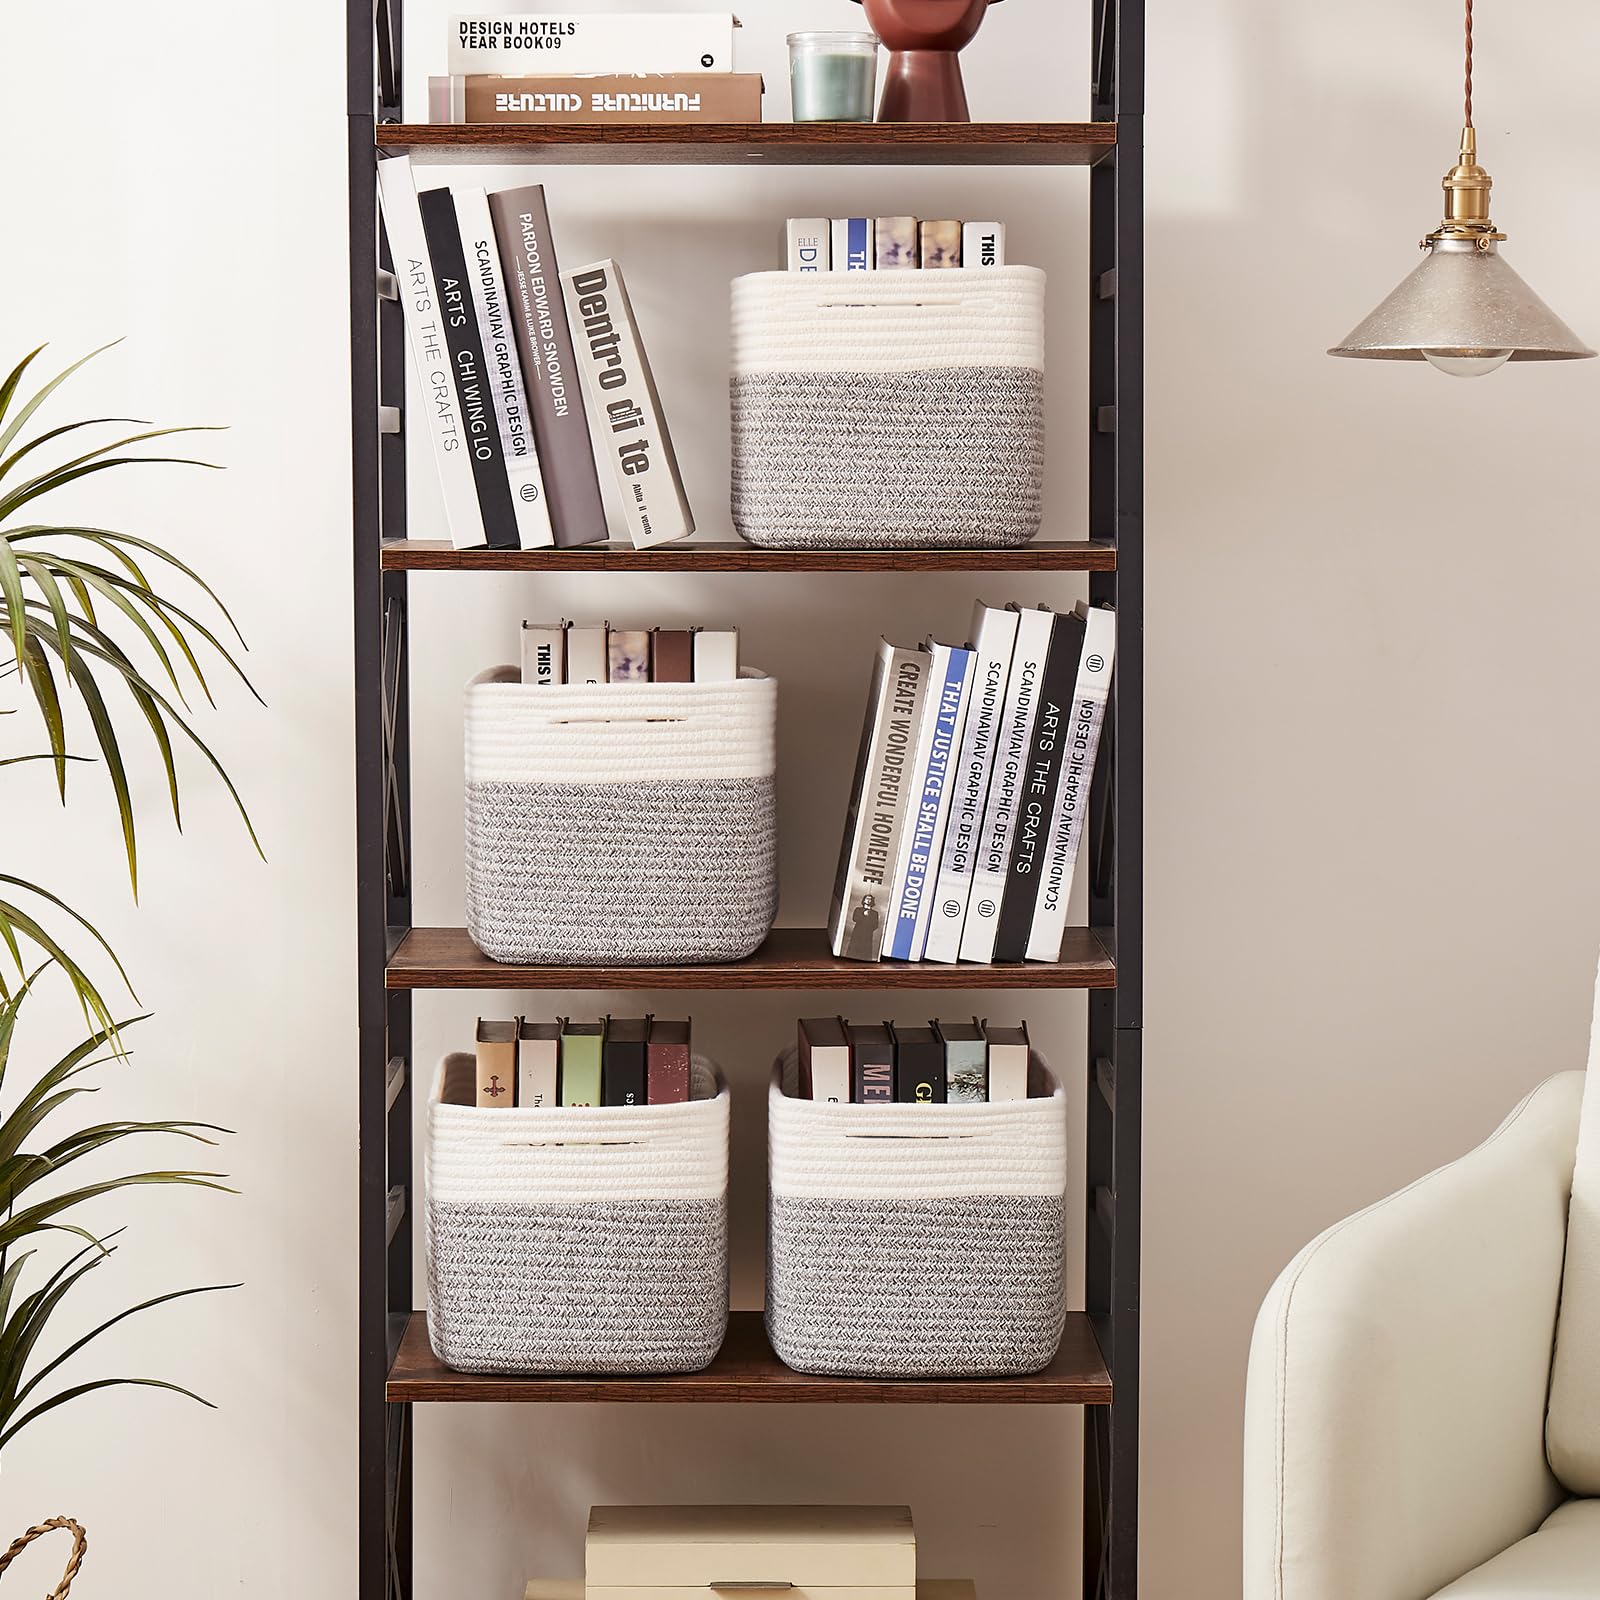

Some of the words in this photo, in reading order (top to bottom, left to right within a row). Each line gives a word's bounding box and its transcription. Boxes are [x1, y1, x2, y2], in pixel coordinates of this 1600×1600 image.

[460, 22, 512, 34] DESIGN
[460, 36, 497, 48] YEAR
[496, 94, 582, 112] CULTURE
[798, 237, 818, 247] ELLE
[982, 234, 995, 266] THIS
[408, 259, 432, 312] ARTS
[442, 278, 467, 328] ARTS
[520, 213, 542, 274] PARDON
[531, 276, 554, 339] EDWARD
[544, 342, 569, 417] SNOWDEN
[572, 268, 627, 390] Dentro
[421, 320, 442, 362] THE
[458, 350, 477, 381] CHI
[474, 240, 505, 339] SCANDINAVIAV
[494, 343, 517, 404] GRAPHIC
[506, 406, 528, 457] DESIGN
[430, 371, 459, 452] CRAFTS
[464, 384, 487, 434] WING
[606, 398, 645, 433] di
[474, 437, 492, 460] LO
[618, 439, 650, 476] te
[641, 514, 652, 535] vento
[538, 644, 551, 675] THIS
[893, 662, 920, 715] CREATE
[939, 682, 962, 726] THAT
[972, 661, 1002, 760] SCANDINAVIAV
[1008, 661, 1036, 760] SCANDINAVIAV
[1040, 702, 1060, 752] ARTS
[876, 720, 910, 808] WONDERFUL
[924, 729, 951, 798] JUSTICE
[1030, 759, 1050, 795] THE
[962, 761, 984, 820] GRAPHIC
[996, 761, 1018, 820] GRAPHIC
[1044, 813, 1073, 911] SCANDINAVIAV
[1063, 752, 1084, 812] GRAPHIC
[1074, 699, 1095, 749] DESIGN
[862, 812, 894, 886] HOMELIFE
[914, 802, 938, 850] SHALL
[952, 823, 973, 874] DESIGN
[987, 823, 1008, 873] DESIGN
[1016, 802, 1042, 874] CRAFTS
[910, 854, 928, 874] BE
[900, 876, 923, 920] DONE
[863, 1064, 890, 1104] ME
